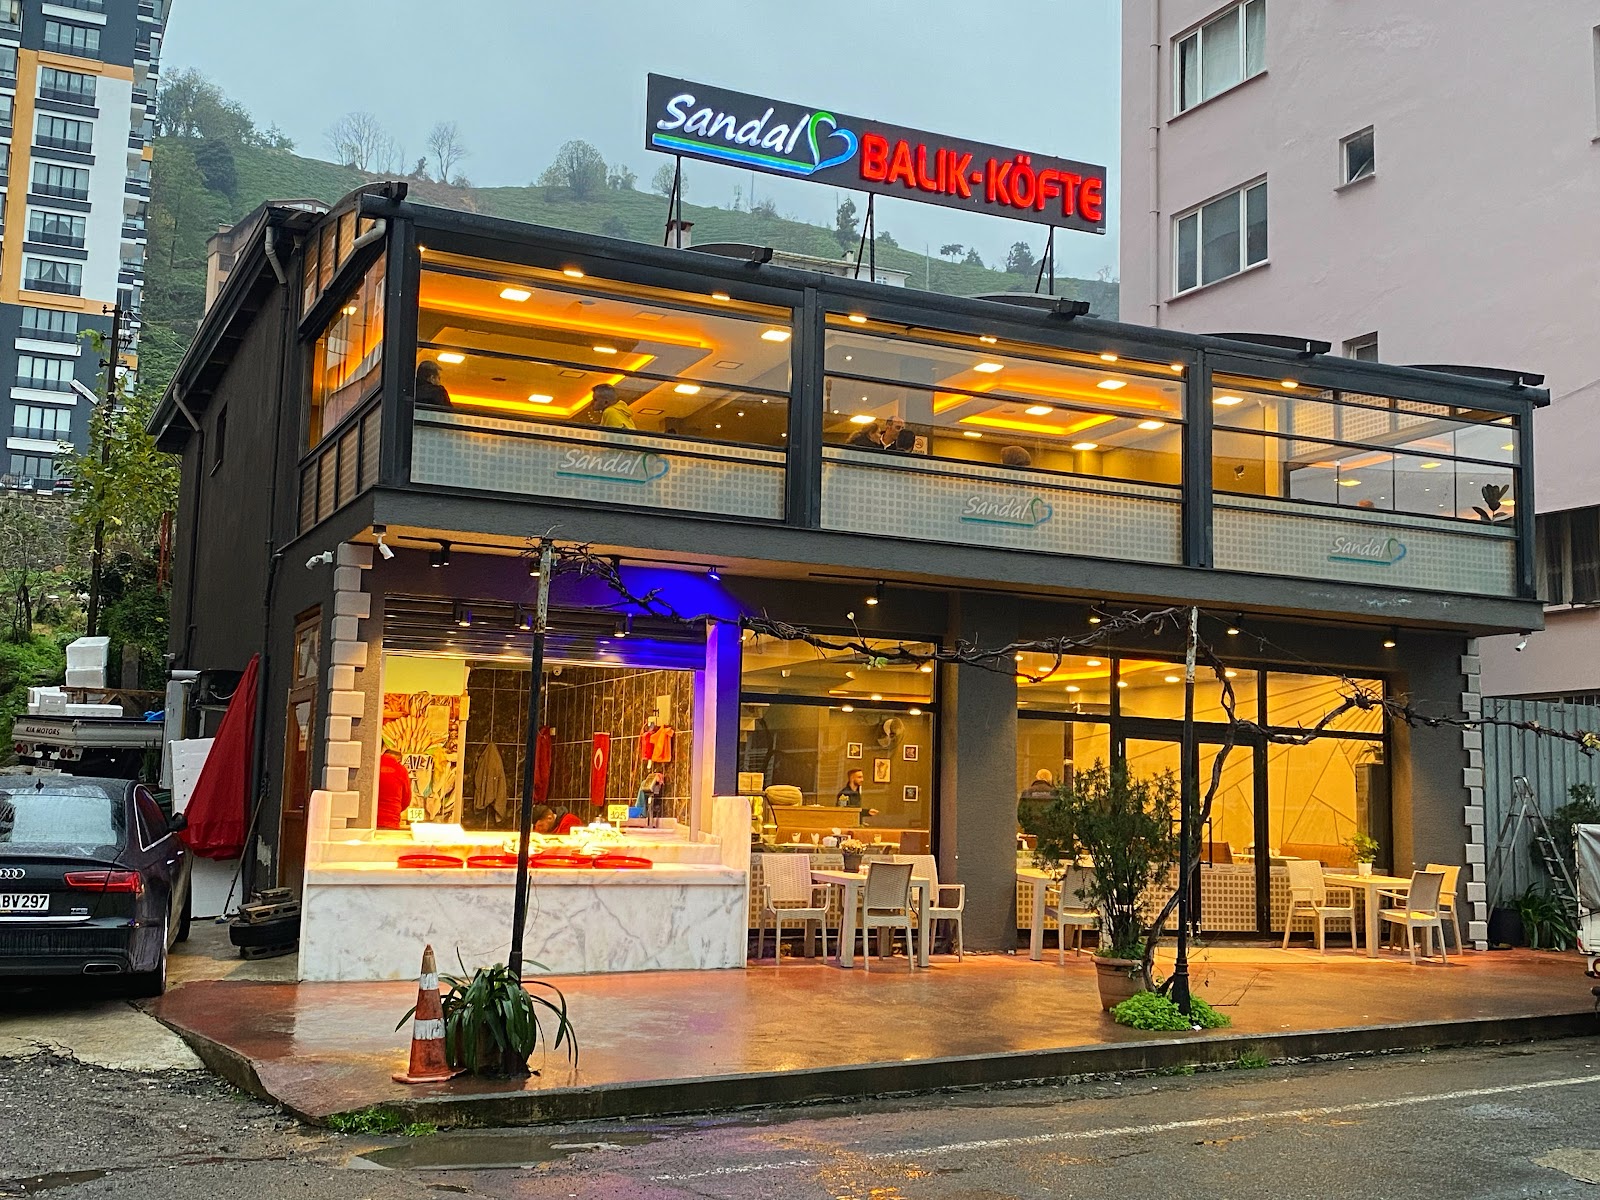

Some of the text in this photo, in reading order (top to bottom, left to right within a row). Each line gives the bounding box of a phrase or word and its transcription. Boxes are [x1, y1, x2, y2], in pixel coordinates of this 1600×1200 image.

[657, 93, 1103, 222] Sandal BALIK-KÖFTE
[560, 448, 644, 476] Sandal
[963, 496, 1031, 520] Sandal
[1331, 536, 1387, 558] Sandal
[36, 727, 61, 736] MOTORS
[0, 895, 20, 908] BV
